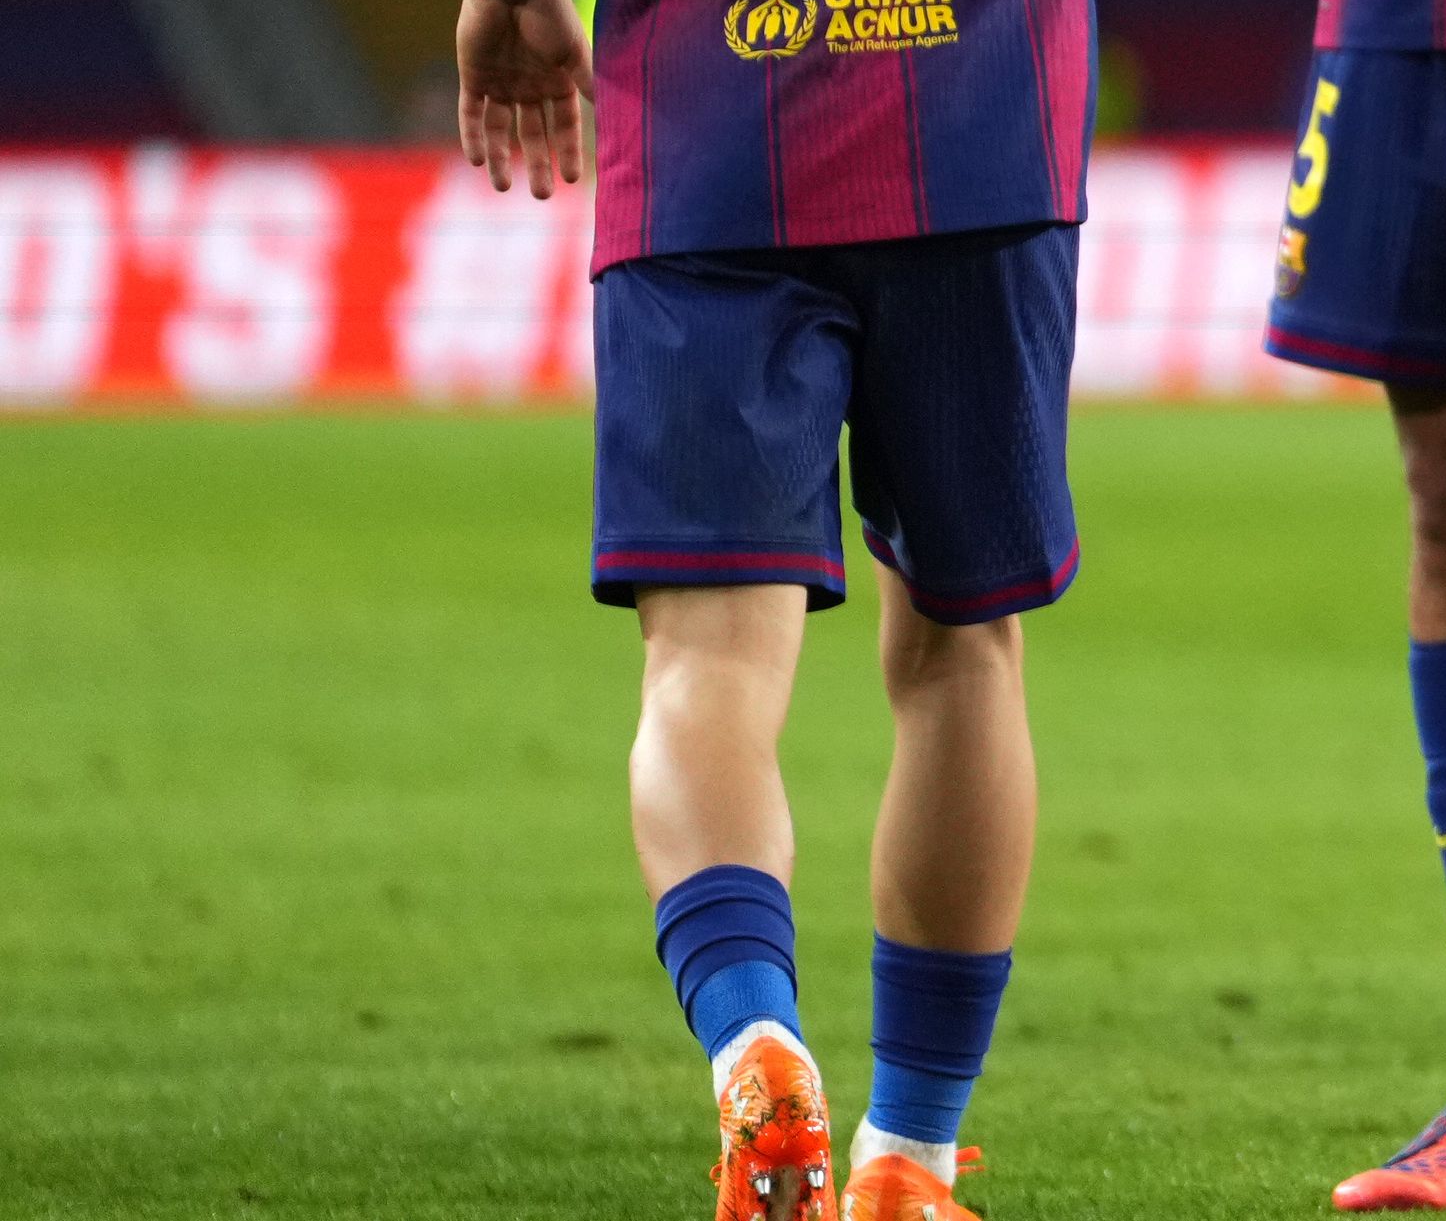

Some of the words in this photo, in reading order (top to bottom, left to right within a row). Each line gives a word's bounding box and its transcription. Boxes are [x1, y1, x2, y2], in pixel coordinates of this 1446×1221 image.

[825, 4, 957, 40] ACNUR
[827, 40, 848, 54] The
[866, 36, 913, 53] Refugee
[915, 31, 960, 49] Agency
[1287, 77, 1341, 218] 5
